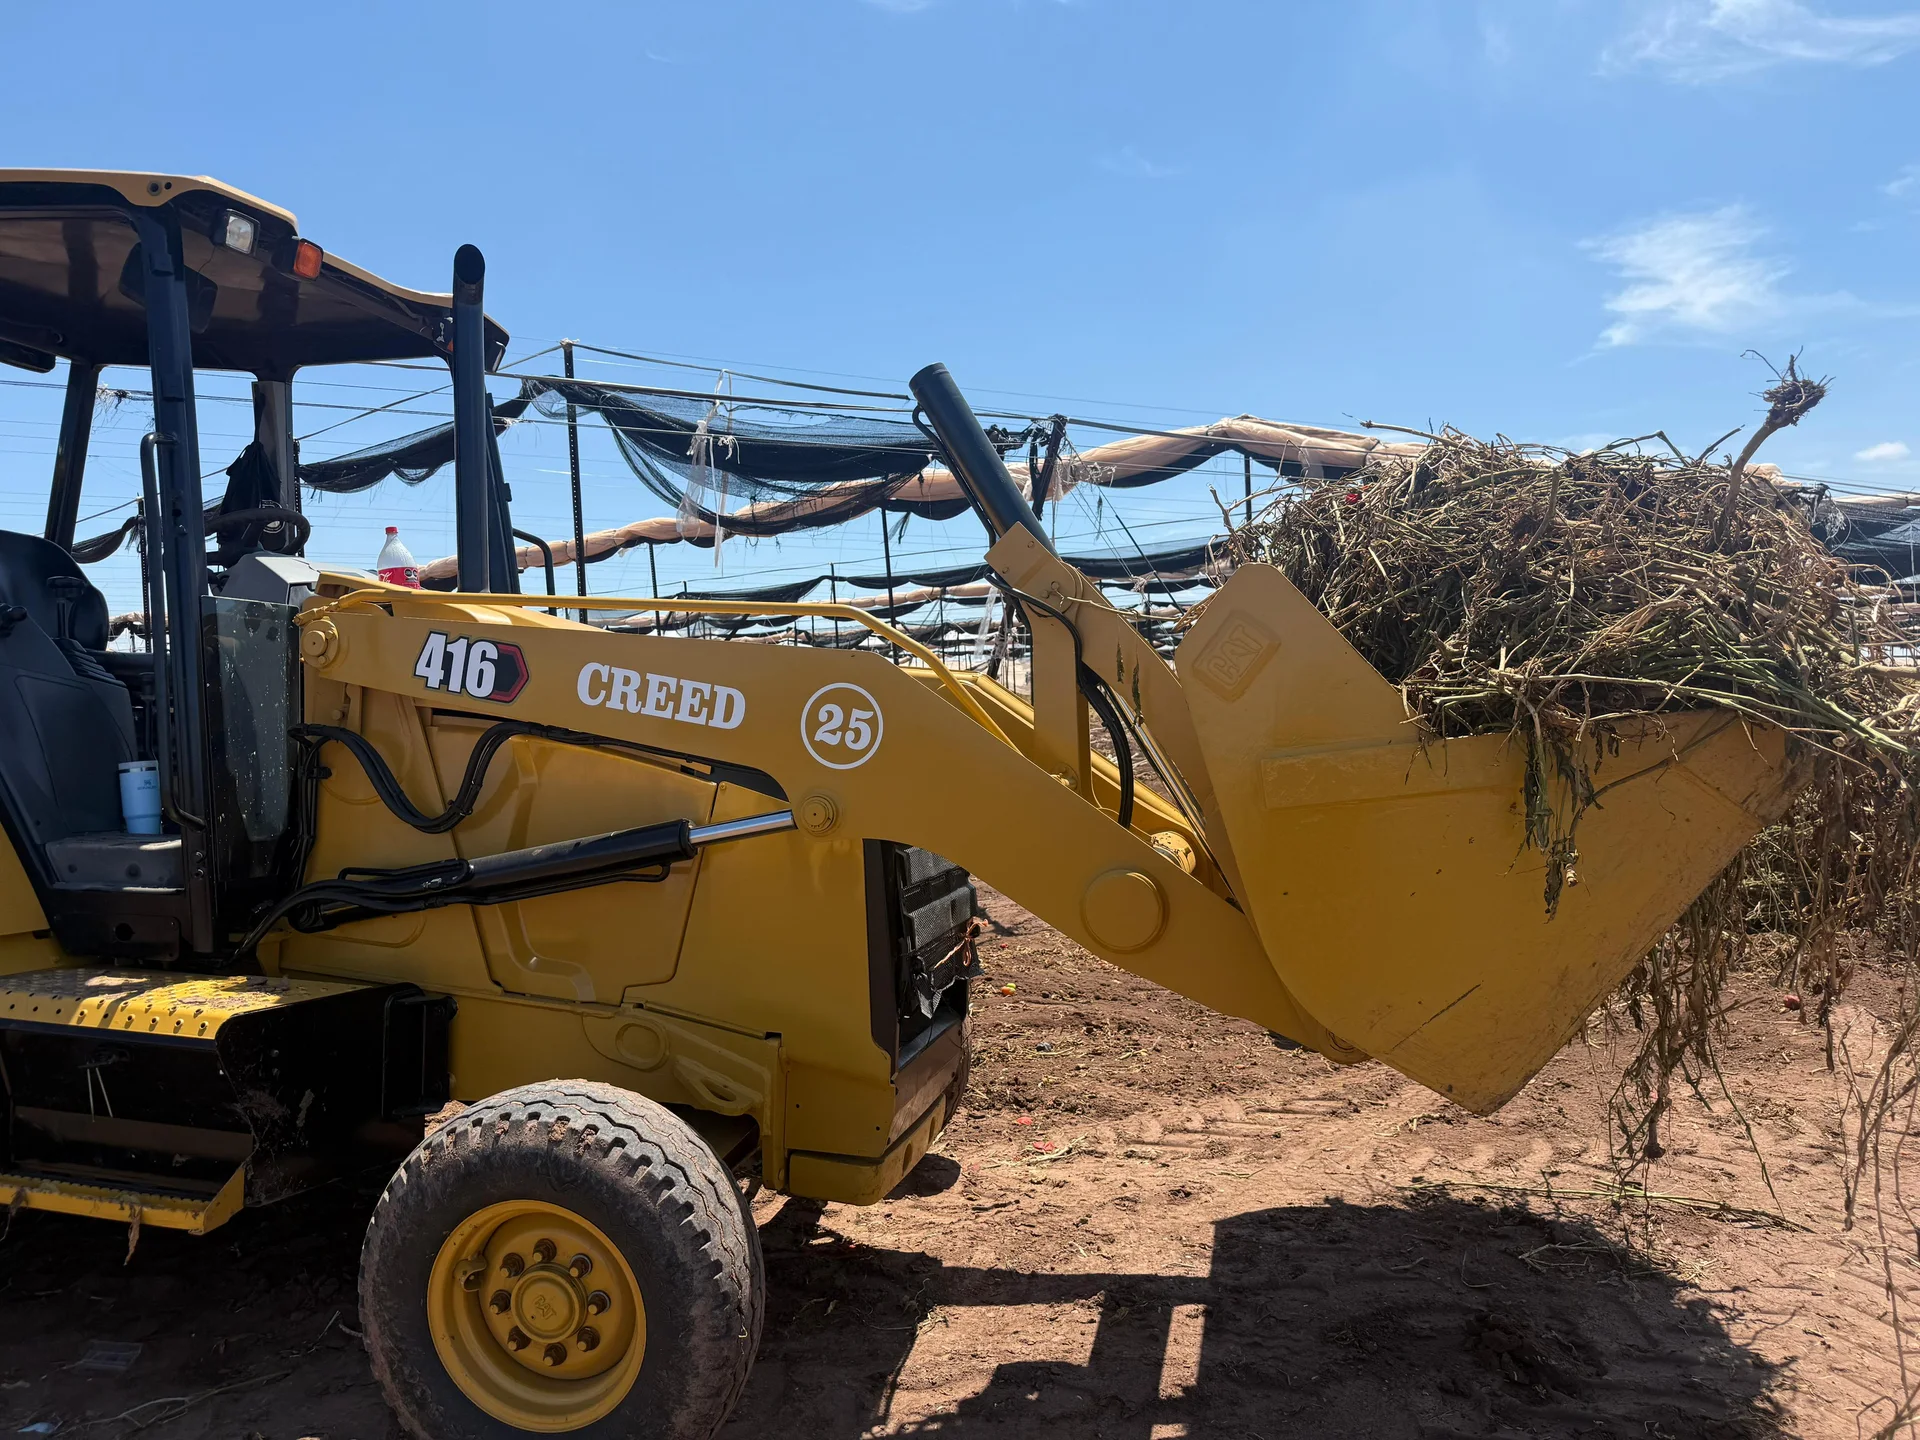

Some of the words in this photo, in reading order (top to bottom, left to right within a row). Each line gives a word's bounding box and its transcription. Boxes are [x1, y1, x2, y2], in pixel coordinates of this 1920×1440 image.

[415, 632, 499, 698] 416
[1206, 623, 1264, 688] CAT
[577, 662, 746, 730] CREED
[814, 703, 874, 750] 25
[533, 1294, 557, 1320] CAT
